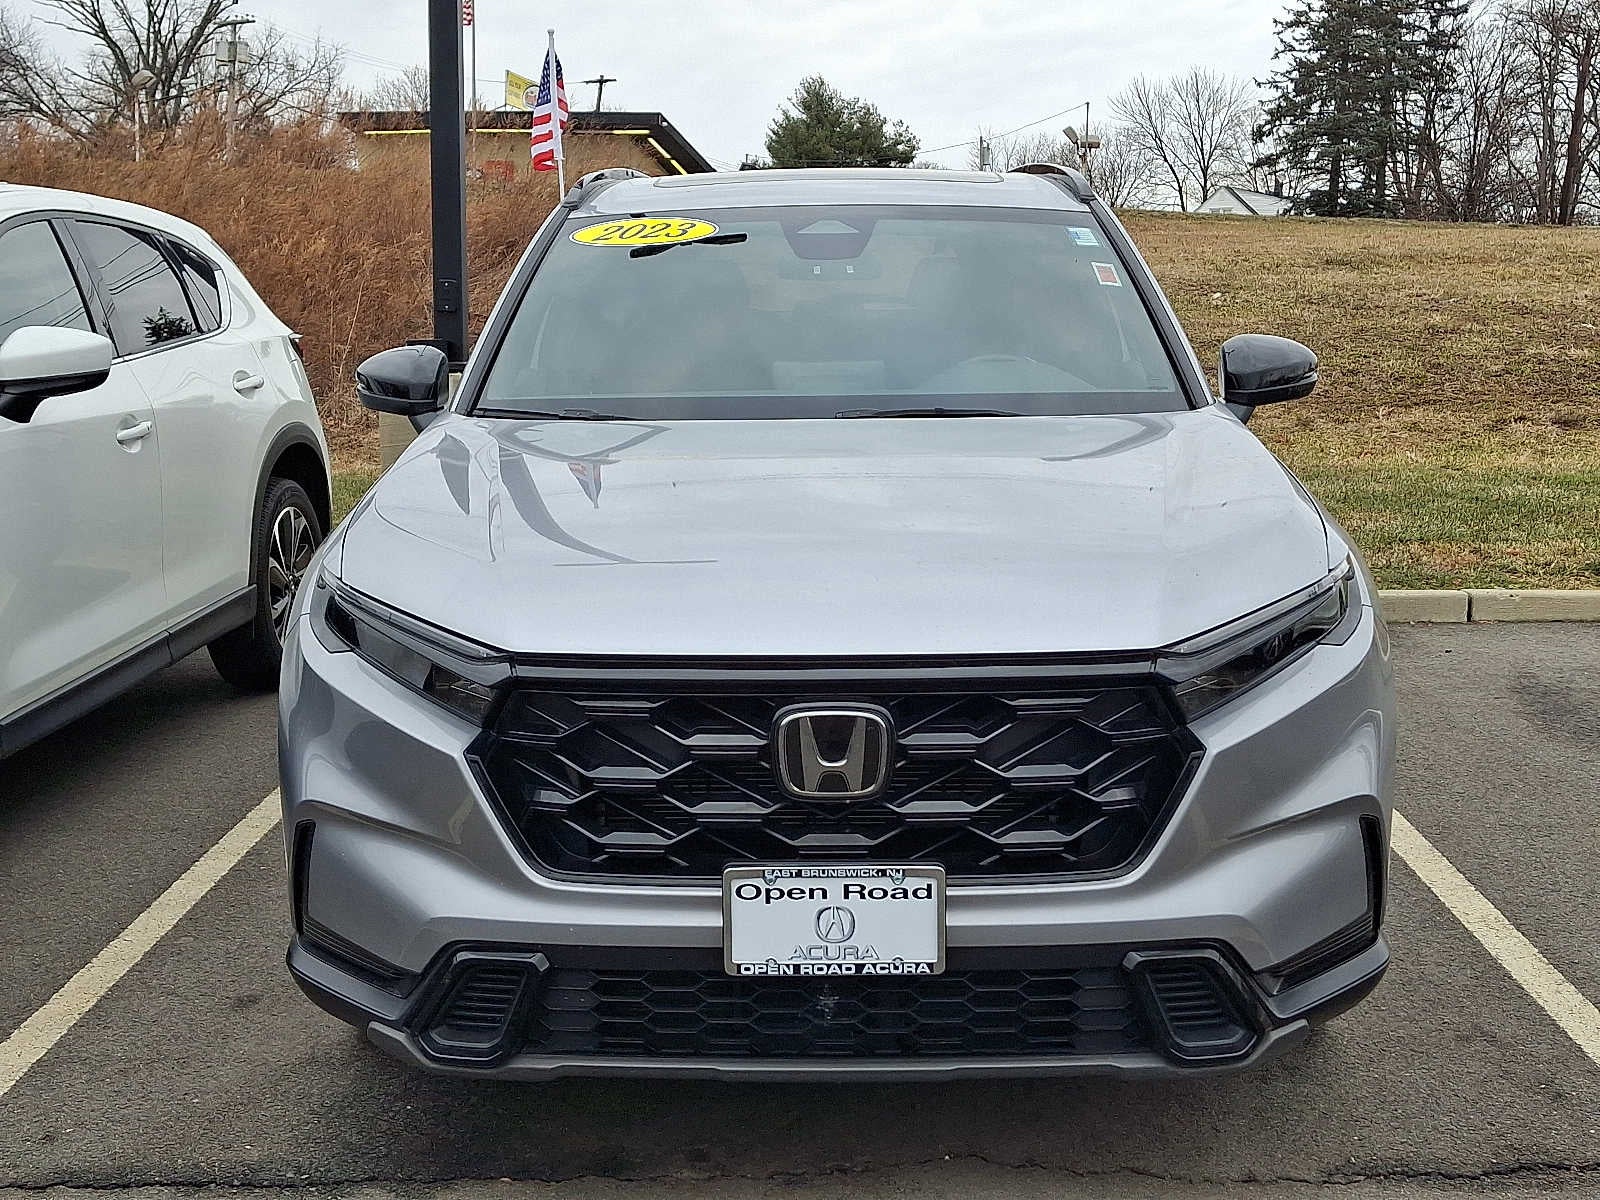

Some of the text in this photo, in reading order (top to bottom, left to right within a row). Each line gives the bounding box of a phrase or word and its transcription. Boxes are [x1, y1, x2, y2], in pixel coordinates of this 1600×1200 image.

[593, 222, 697, 241] 2023
[764, 869, 798, 877] EAST
[886, 869, 903, 877] NJ
[735, 884, 933, 904] Open Road
[788, 945, 880, 961] ACURA
[740, 963, 931, 975] OPEN ROAD ACURA
